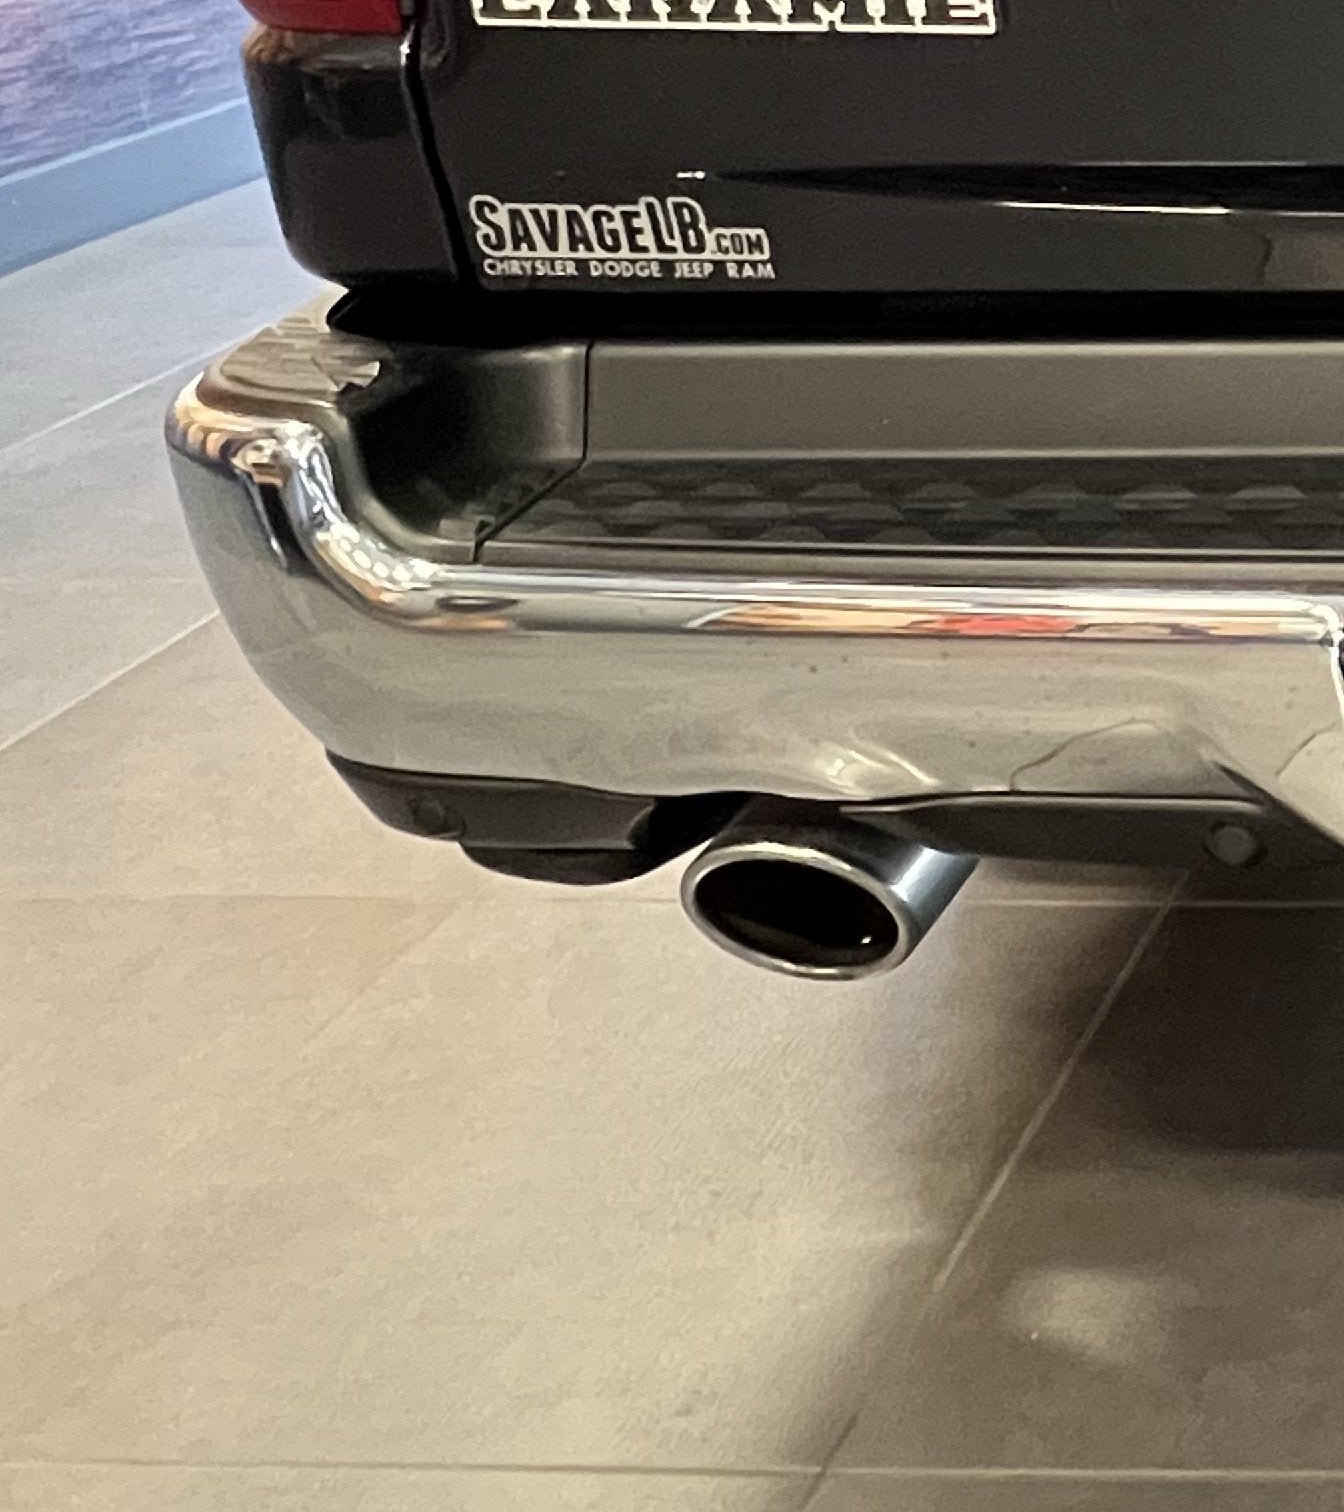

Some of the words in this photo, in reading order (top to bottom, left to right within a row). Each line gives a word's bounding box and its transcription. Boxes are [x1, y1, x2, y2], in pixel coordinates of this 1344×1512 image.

[484, 260, 578, 277] CHRYSLER
[589, 261, 663, 278] DODGE
[673, 262, 714, 278] JEEP
[727, 262, 775, 279] RAM
